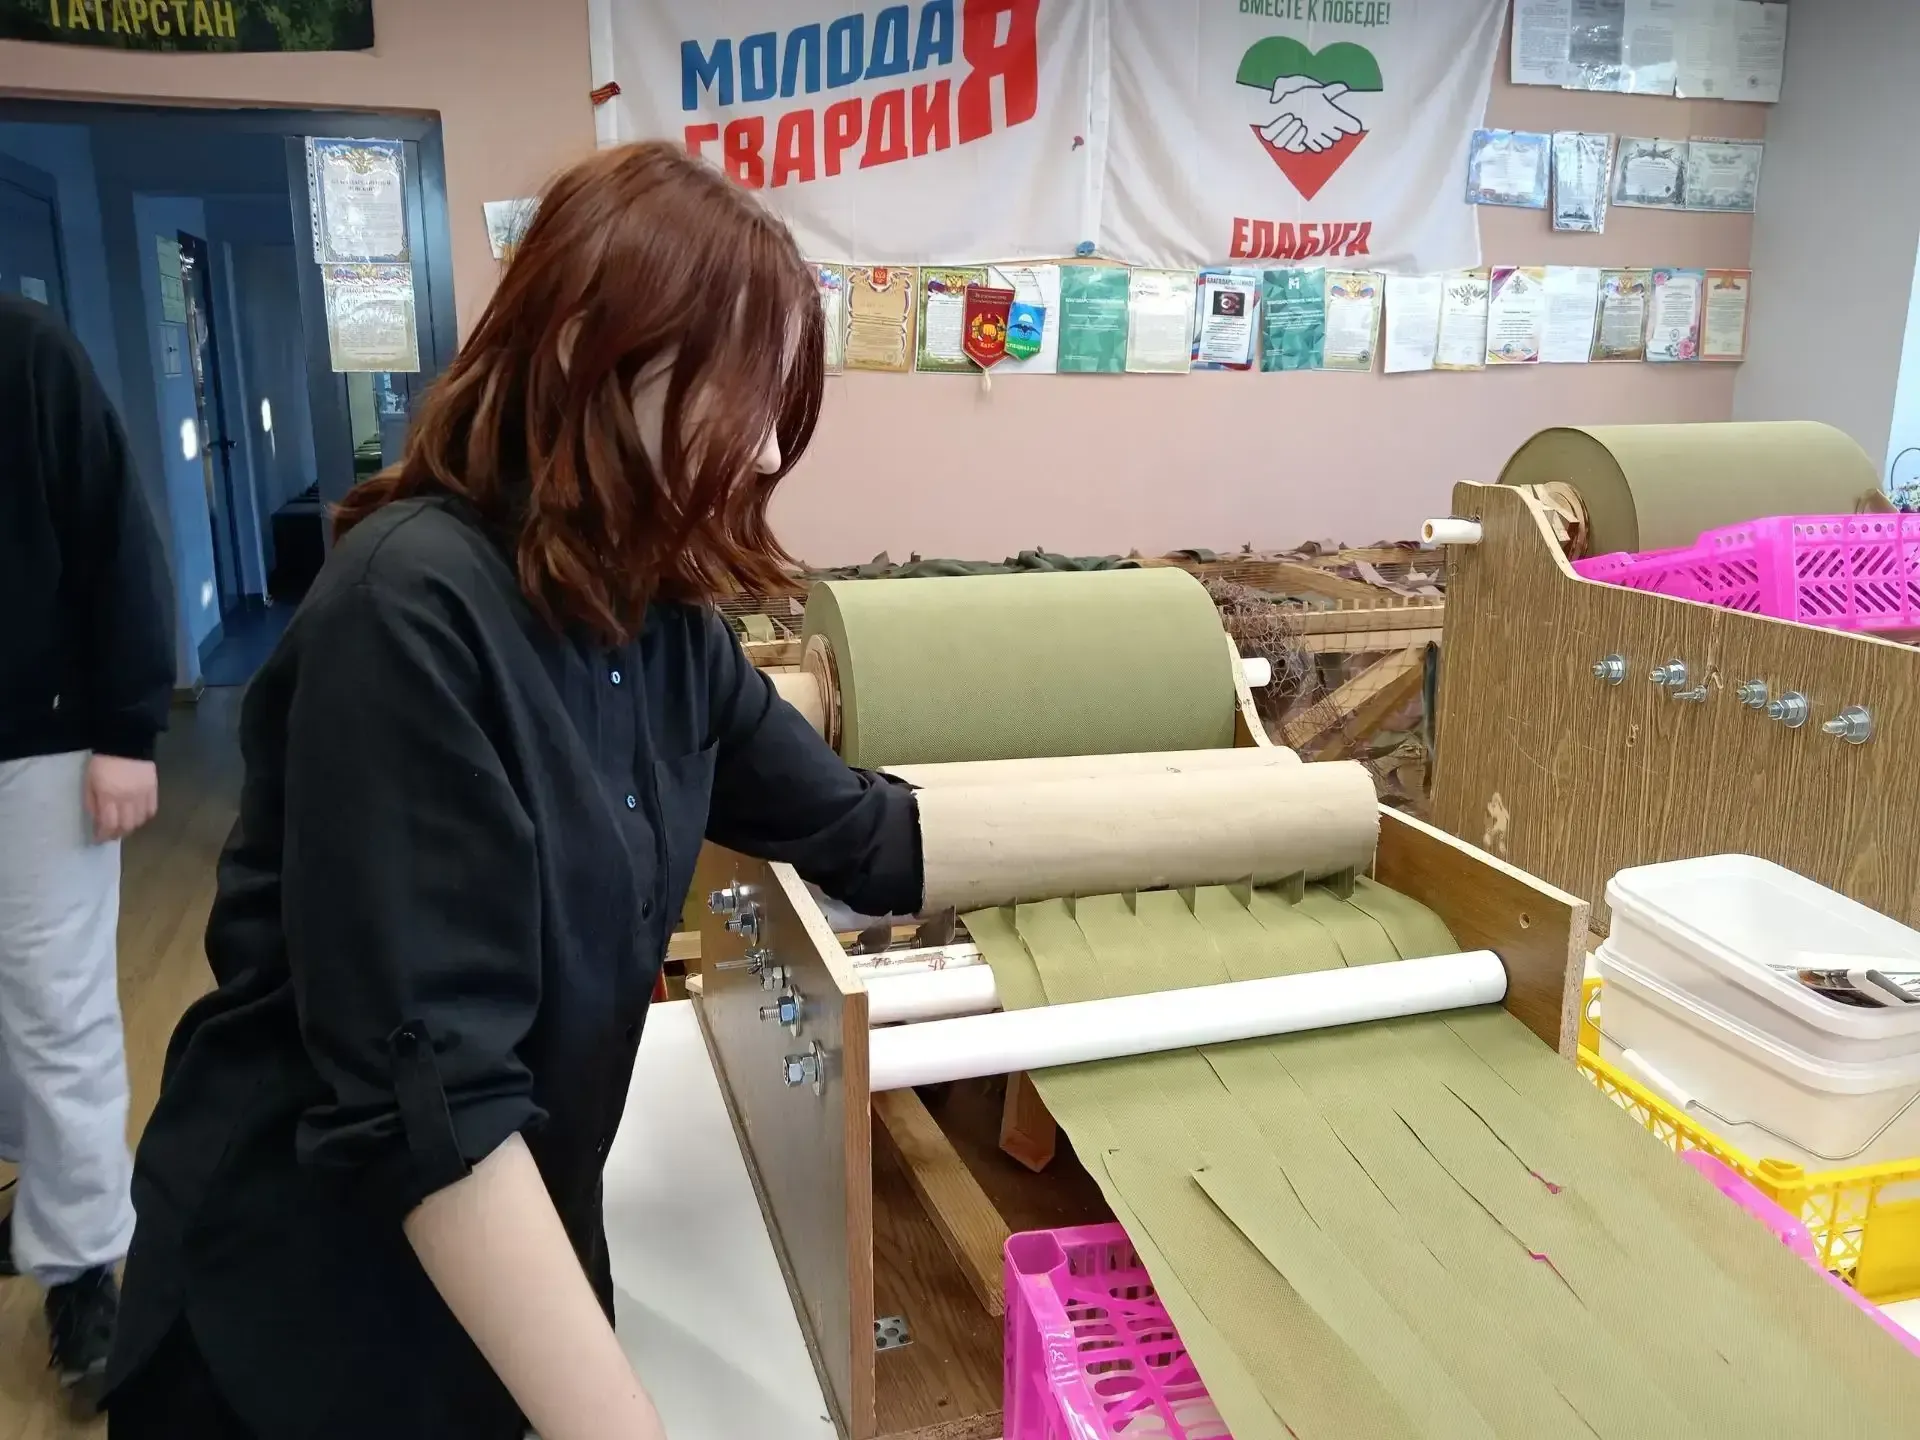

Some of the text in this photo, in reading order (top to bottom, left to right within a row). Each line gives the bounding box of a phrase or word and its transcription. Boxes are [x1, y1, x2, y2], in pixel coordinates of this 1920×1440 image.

[50, 0, 236, 38] ТАТАРСТАН
[1239, 0, 1303, 20] ВМЕСТЕ
[1322, 0, 1391, 27] ПОБЕДЕ!
[1229, 217, 1372, 260] ЕЛАБУГА
